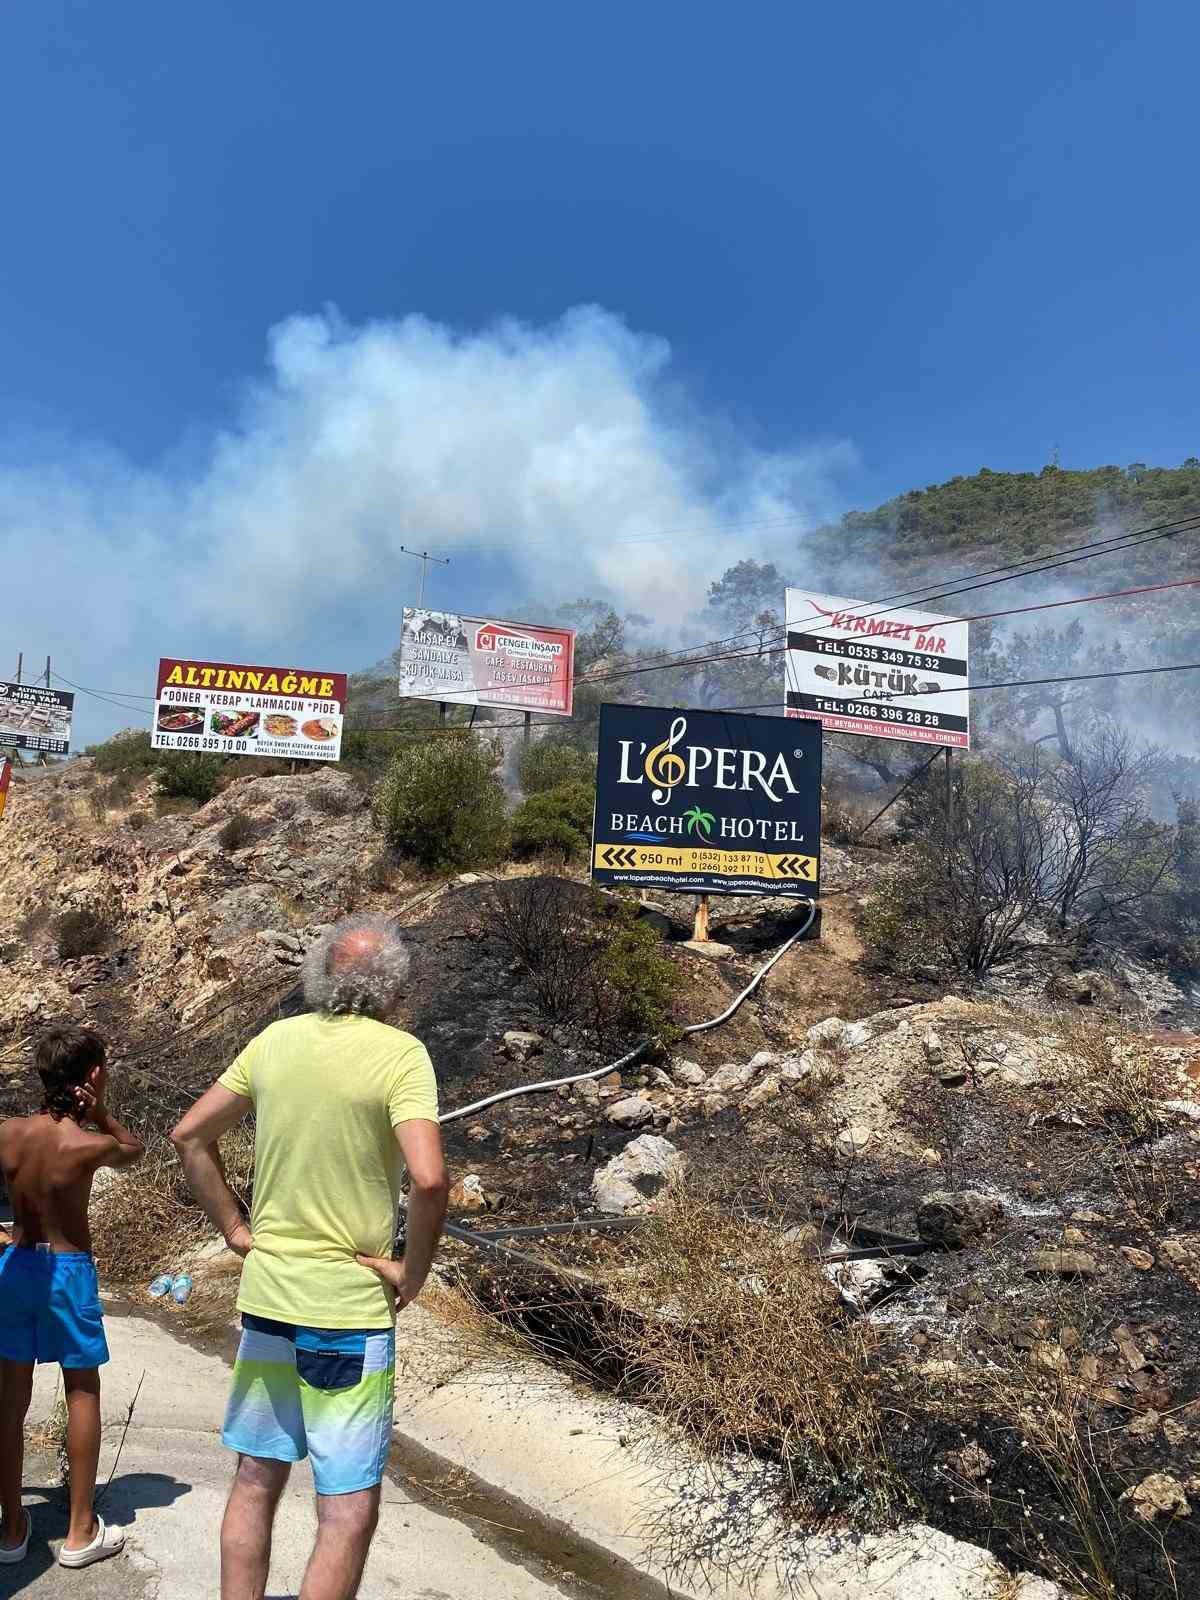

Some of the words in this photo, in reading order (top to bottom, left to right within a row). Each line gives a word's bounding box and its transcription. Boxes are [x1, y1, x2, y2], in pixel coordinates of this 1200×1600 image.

[914, 634, 946, 654] BAR
[816, 640, 845, 654] TEL:
[848, 645, 878, 660] 0535
[881, 650, 904, 663] 349
[906, 654, 922, 666] 75
[924, 657, 940, 670] 32
[166, 665, 334, 697] ALTINNAĞME
[39, 694, 60, 705] YAPI
[816, 698, 844, 713] TEL:
[847, 703, 878, 718] 0266
[881, 708, 903, 721] 396
[906, 712, 921, 724] 28
[924, 715, 939, 726] 28
[155, 734, 175, 747] TEL:
[176, 736, 200, 749] 0266
[202, 737, 219, 750] 395
[222, 739, 234, 751] 10
[235, 739, 248, 752] 00
[616, 716, 800, 806] L'OPERA
[611, 813, 684, 834] BEACH
[720, 817, 804, 842] HOTEL
[640, 853, 663, 865] 950
[666, 855, 683, 866] mt
[699, 852, 721, 862] (532)
[723, 853, 739, 863] 133
[740, 854, 751, 863] 87
[754, 855, 765, 864] 10
[699, 862, 721, 872] (266)
[722, 864, 738, 873] 392
[741, 865, 751, 873] 11
[754, 866, 764, 874] 12
[613, 873, 704, 884] www.loperabeachhotel.com
